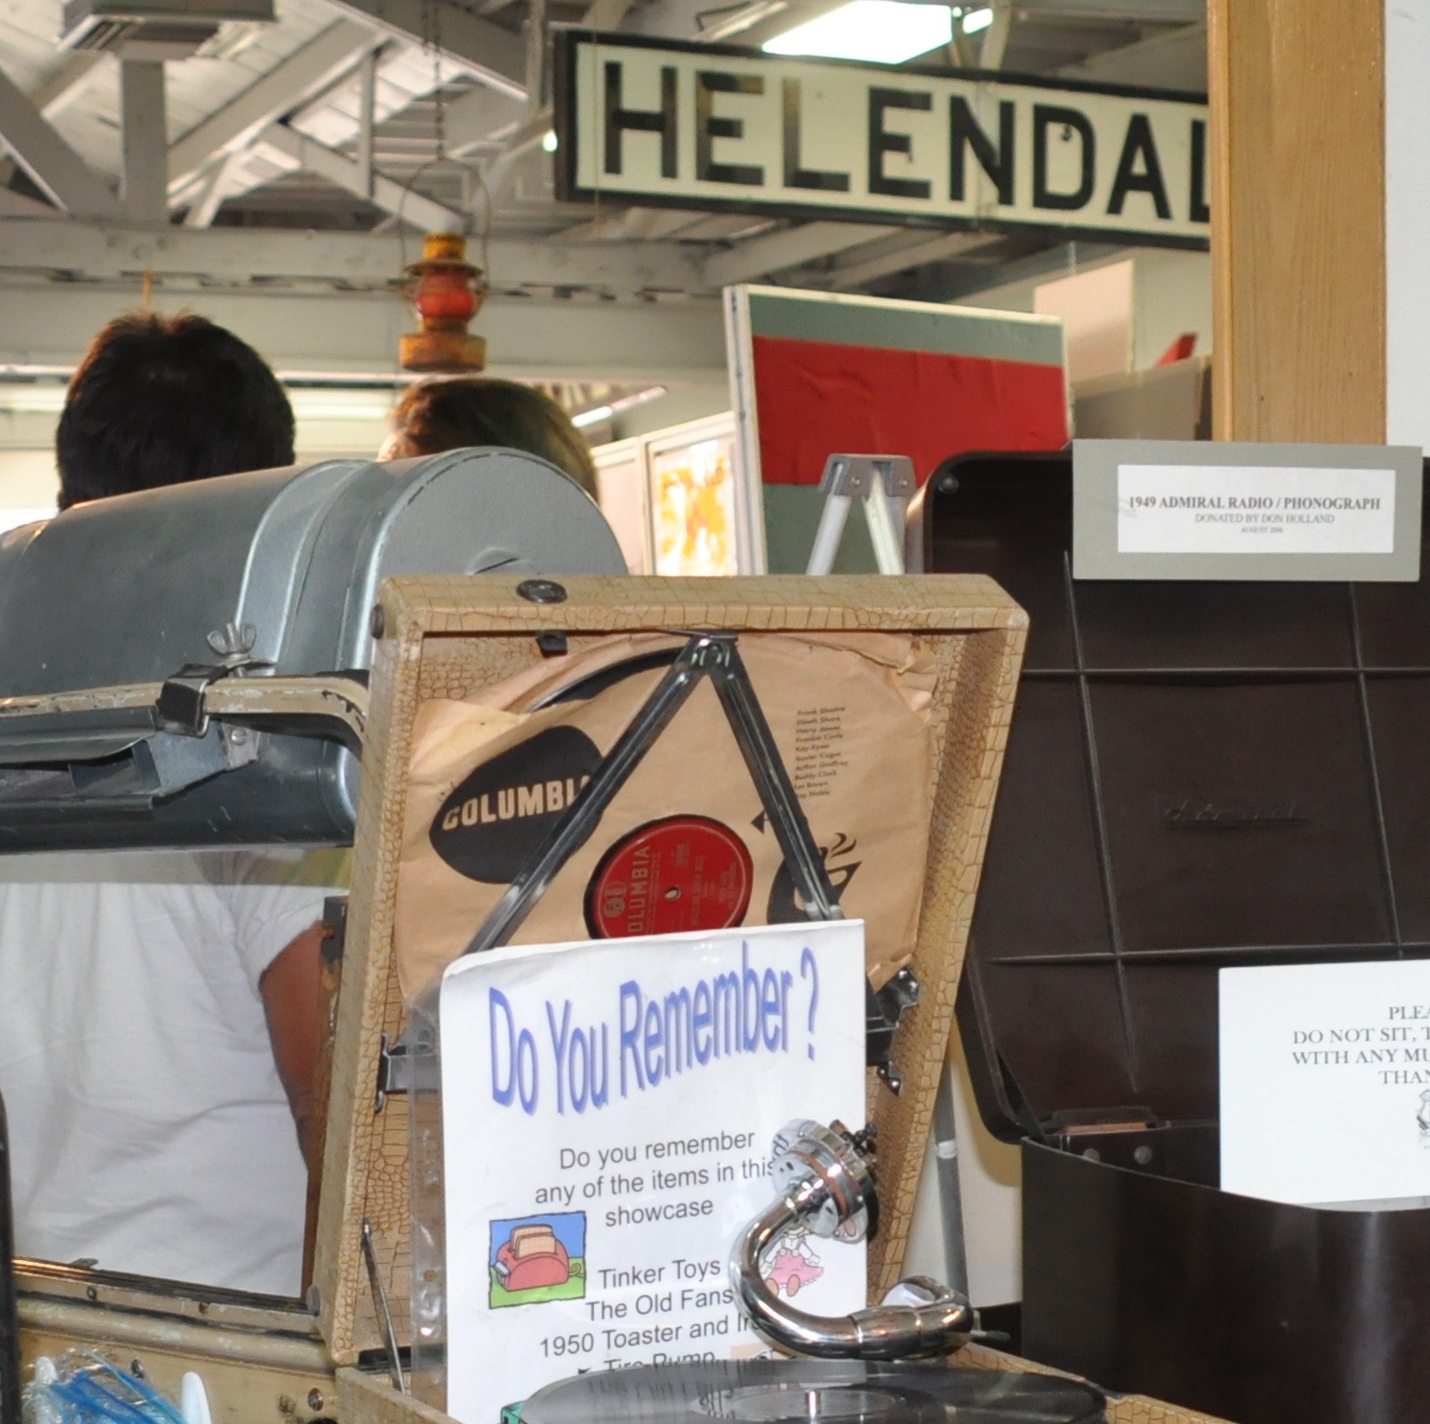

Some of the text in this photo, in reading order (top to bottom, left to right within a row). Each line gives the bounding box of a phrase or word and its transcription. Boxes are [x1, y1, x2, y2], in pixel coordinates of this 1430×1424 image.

[1129, 496, 1380, 510] 1949 ADMIRAL RADIO PHONOGRAPH
[1195, 514, 1334, 524] DONATED BY DON HOLLAND
[442, 775, 591, 832] COLUMBI
[489, 940, 819, 1116] Do You Remember ?
[1293, 1029, 1324, 1044] DO
[1329, 1028, 1376, 1043] NOT
[1379, 1026, 1417, 1043] SIT,
[1292, 1050, 1349, 1066] WITH
[1355, 1049, 1398, 1065] ANY
[560, 1130, 756, 1170] Do you remember
[535, 1156, 775, 1206] any of the items in this
[605, 1197, 714, 1228] showcase
[598, 1258, 721, 1291] Tinker Toys
[586, 1286, 735, 1322] The Old Fans
[539, 1317, 729, 1359] 1950 Toaster and
